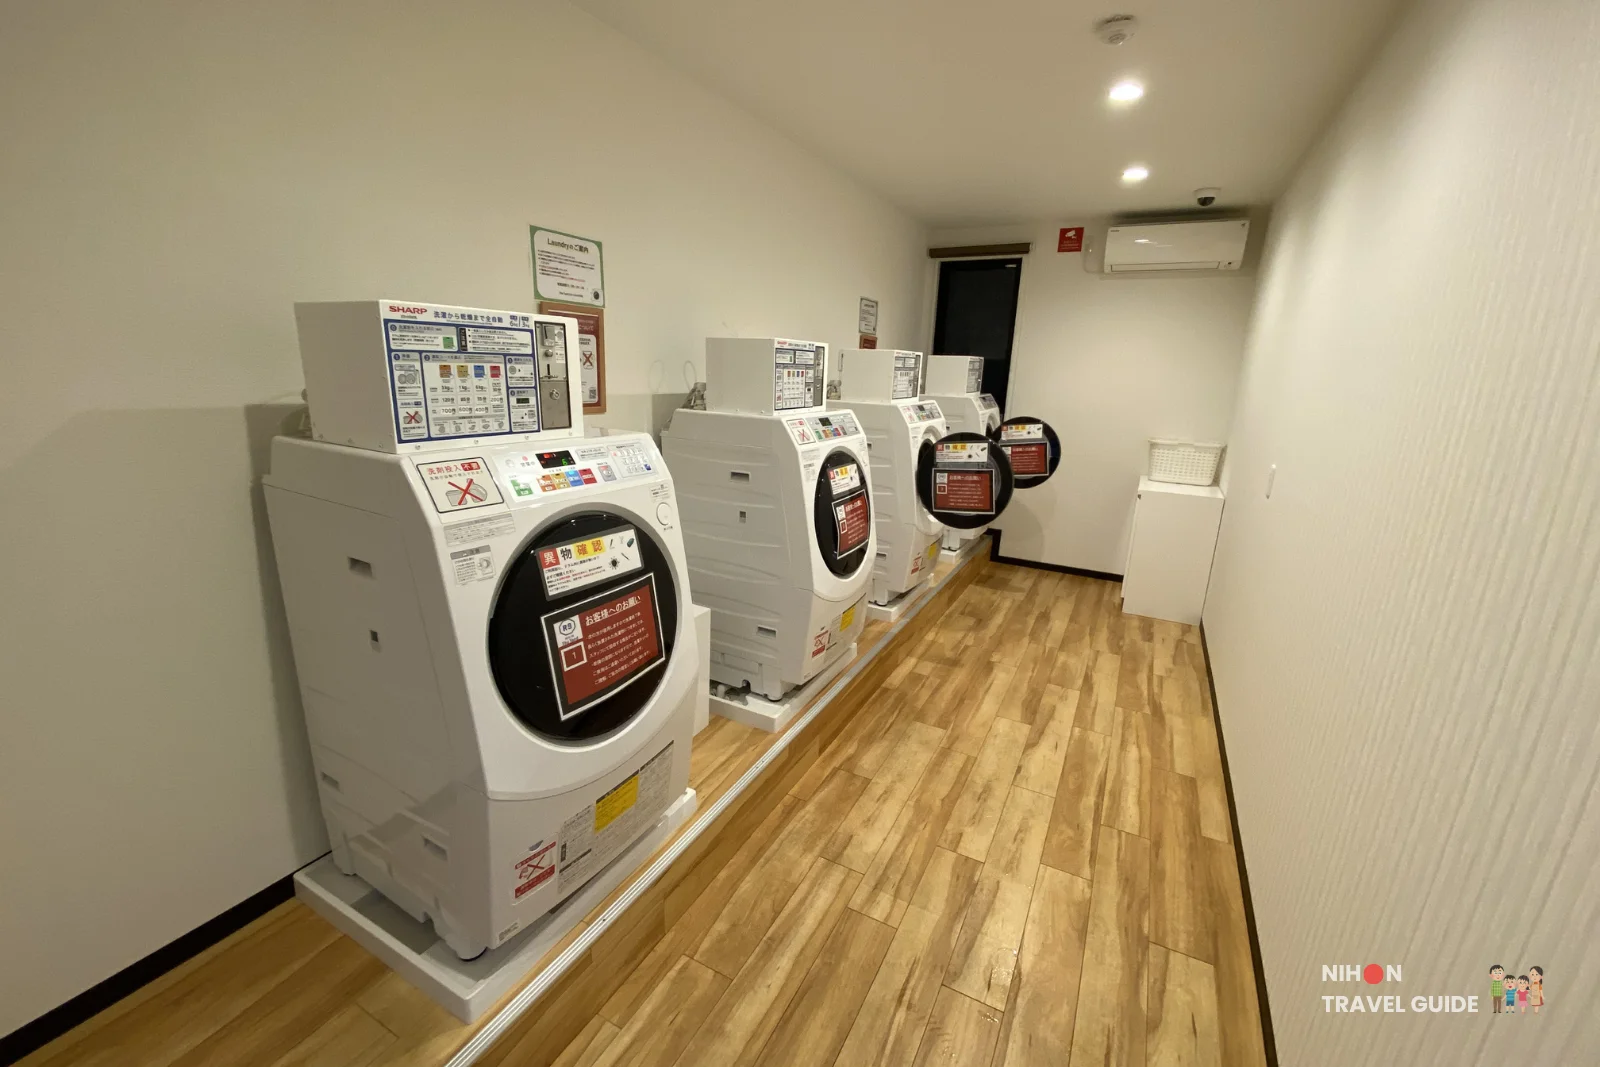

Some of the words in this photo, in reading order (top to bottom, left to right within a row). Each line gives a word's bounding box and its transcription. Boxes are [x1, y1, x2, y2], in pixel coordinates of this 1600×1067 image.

[389, 305, 427, 315] SHARP
[585, 596, 641, 626] お客様へのお願い
